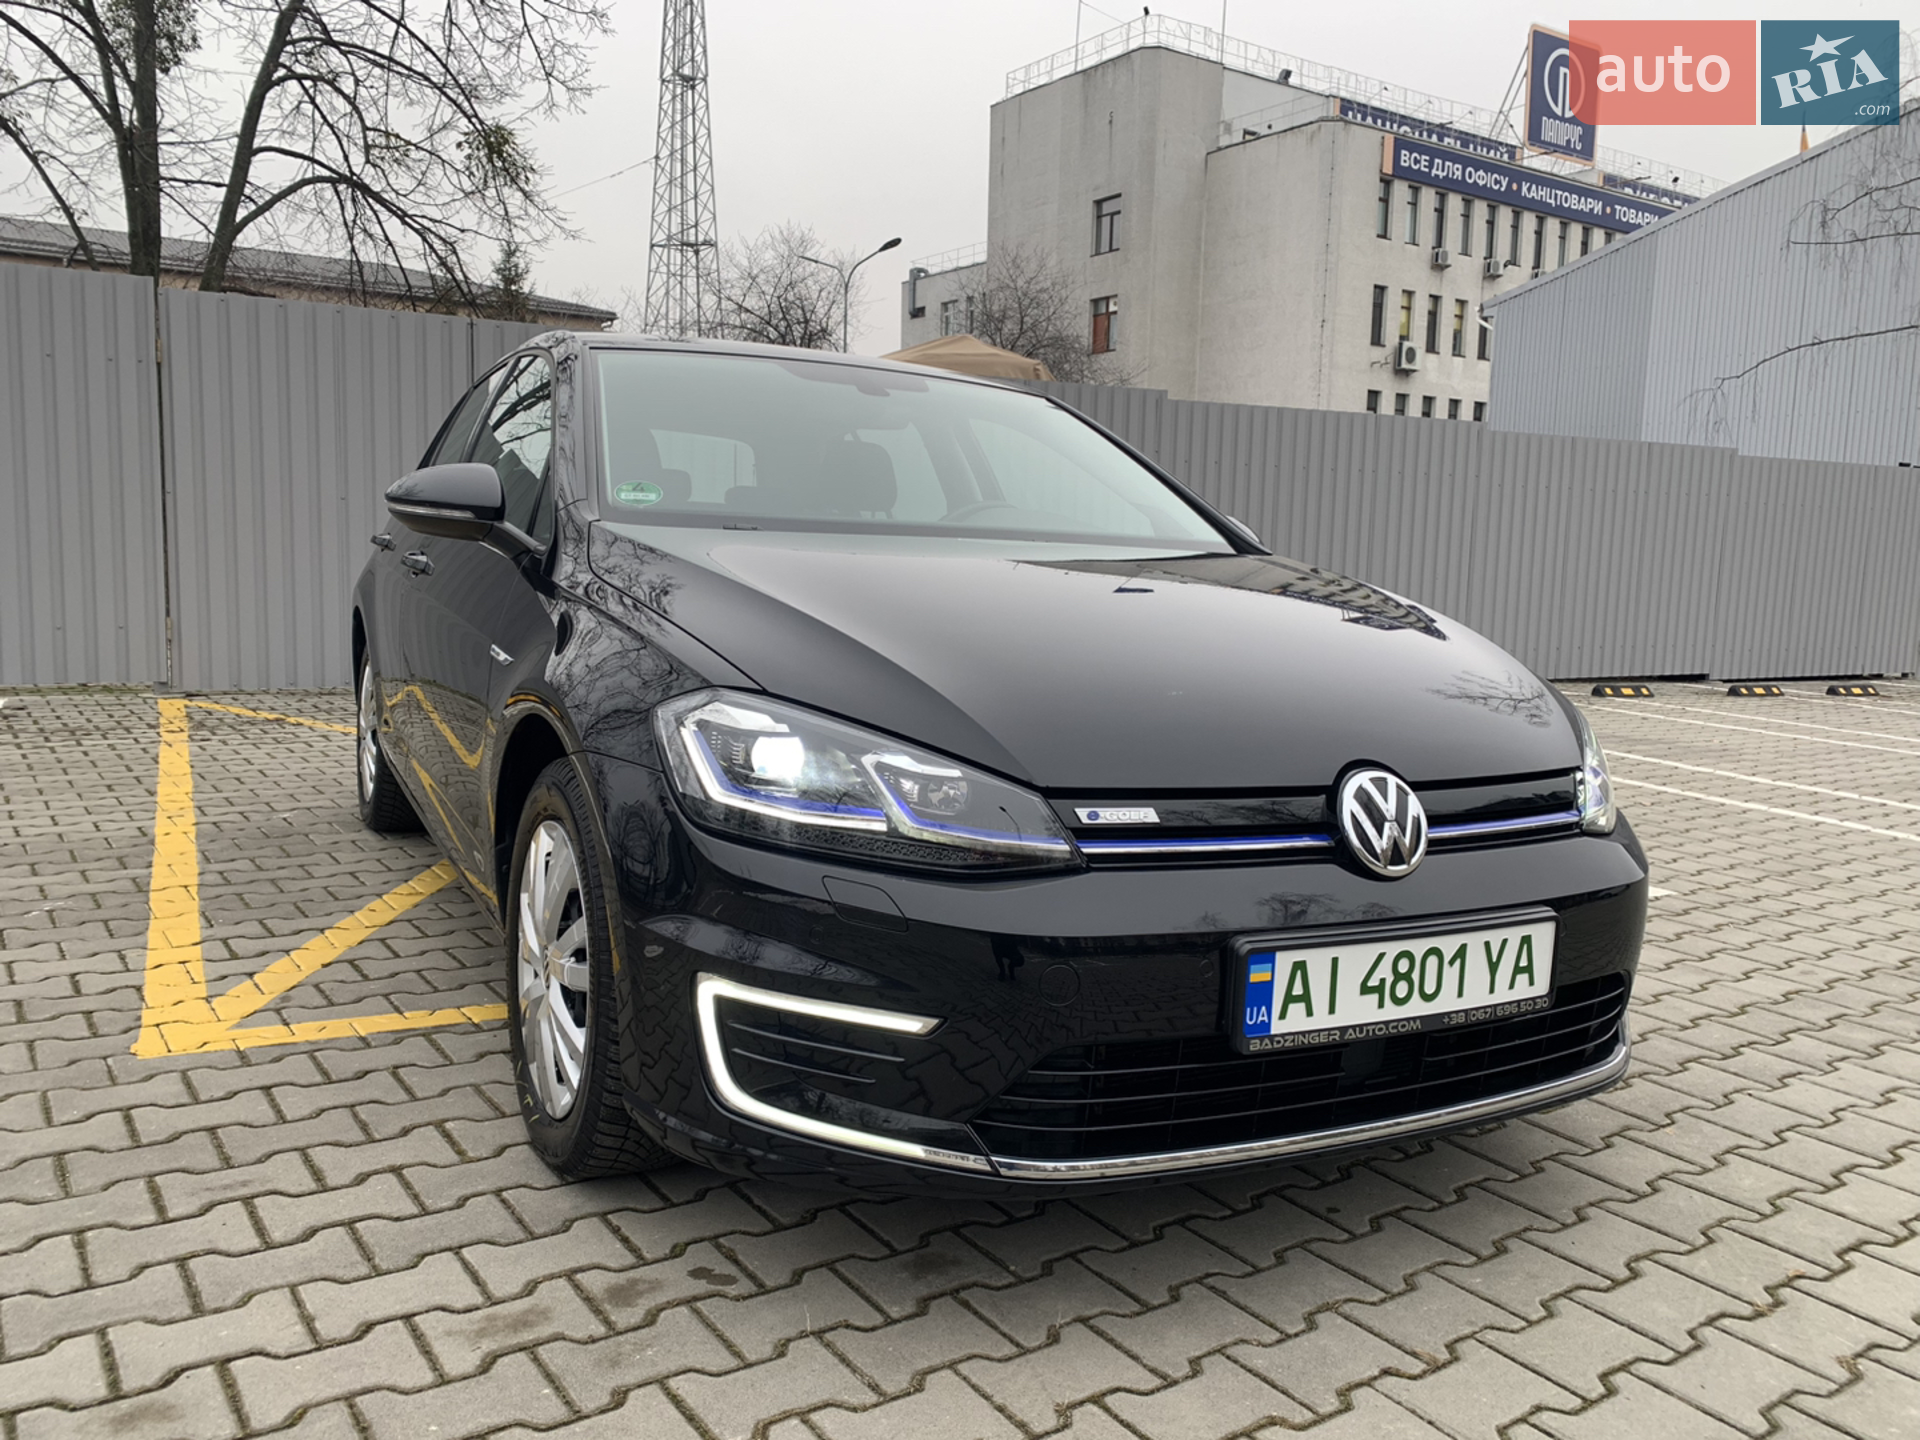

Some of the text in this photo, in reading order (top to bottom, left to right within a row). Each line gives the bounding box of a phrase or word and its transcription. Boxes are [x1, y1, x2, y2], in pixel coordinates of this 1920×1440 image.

[1541, 116, 1583, 150] ПАПІРУС
[1400, 150, 1430, 173] ВСЕ
[1431, 158, 1462, 180] ДЛЯ
[1465, 167, 1509, 192] ОФІСУ
[1521, 181, 1603, 216] КАНЦТОВАРИ
[1278, 934, 1536, 1021] AI 4801 YA
[1246, 1005, 1269, 1025] UA
[1250, 1019, 1421, 1051] BADZINGER AUTO.COM
